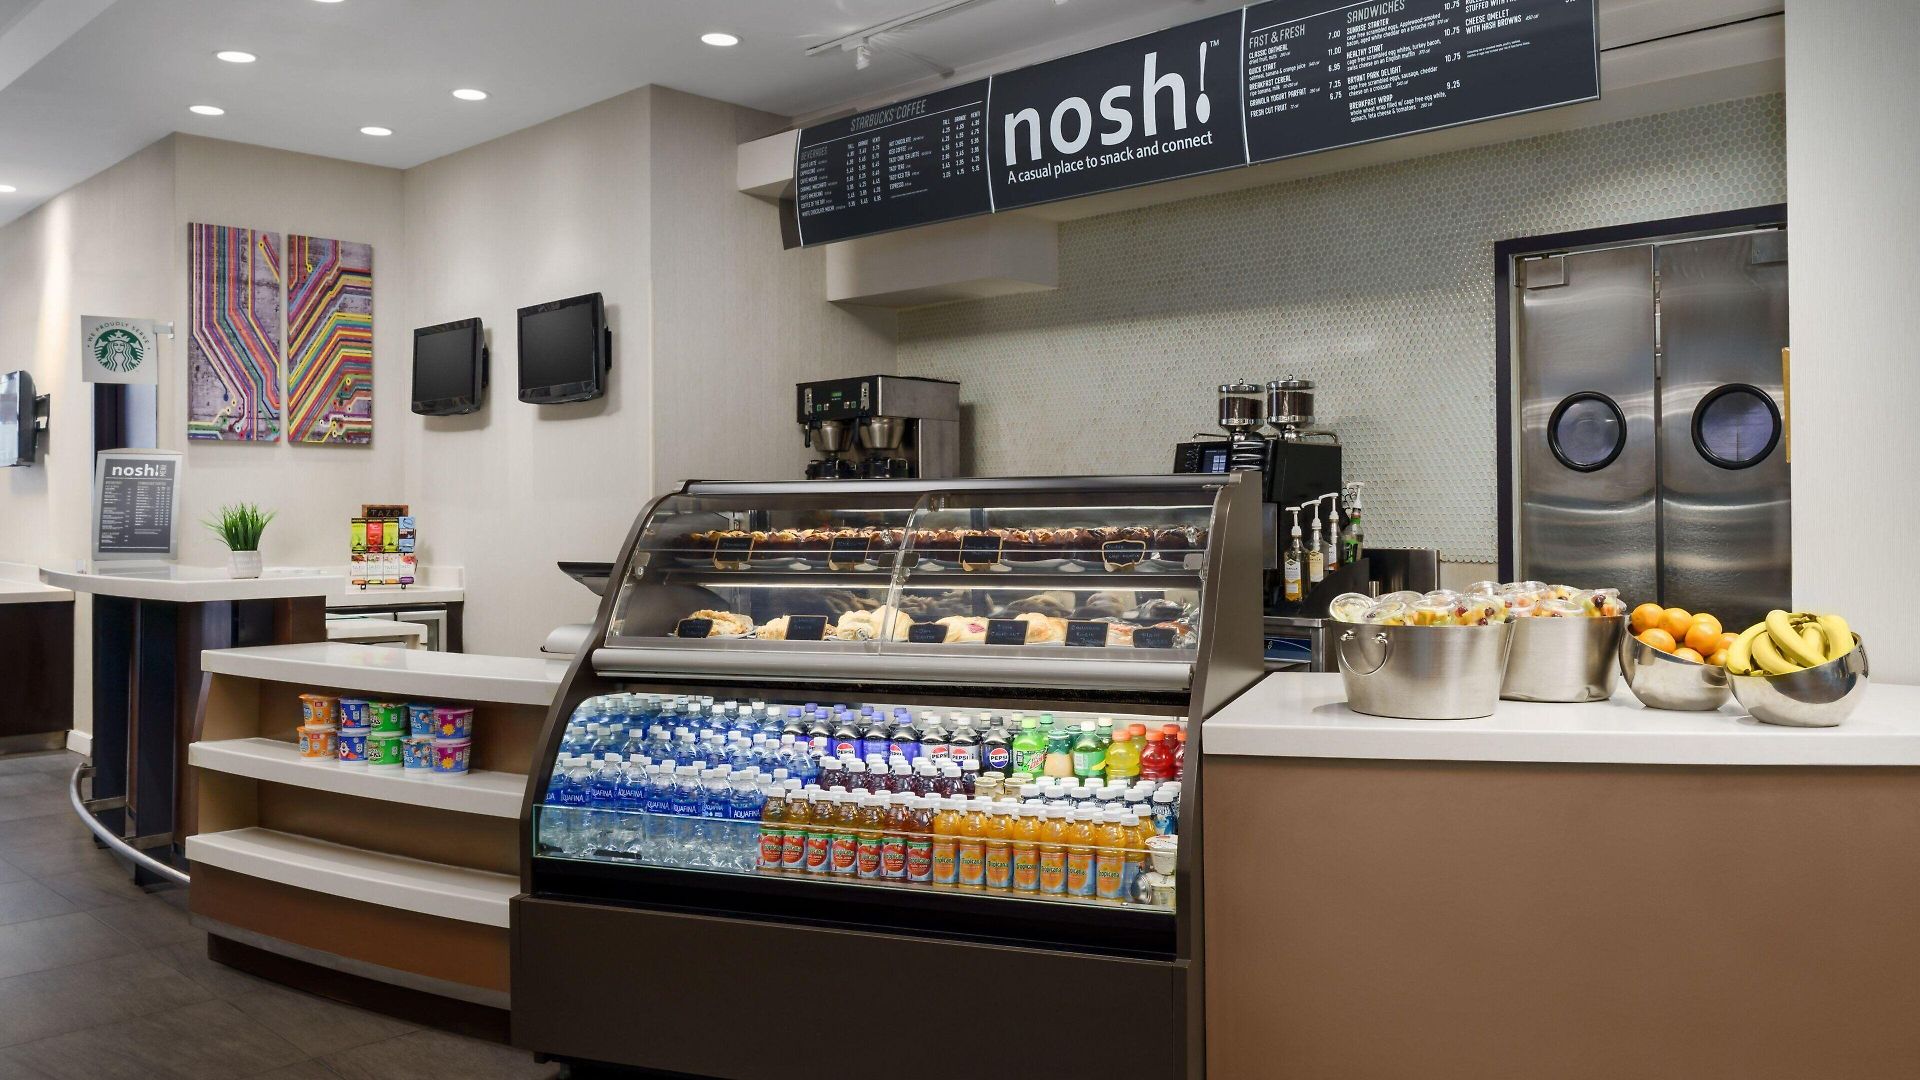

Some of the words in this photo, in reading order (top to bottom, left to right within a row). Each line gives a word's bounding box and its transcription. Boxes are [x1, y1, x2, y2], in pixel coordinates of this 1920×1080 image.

[1444, 0, 1460, 10] 10.75
[1466, 2, 1488, 13] STUFFED
[1347, 0, 1405, 23] SANDWICHES
[1466, 15, 1485, 26] CHEESE
[1487, 9, 1509, 21] OMELET
[1368, 18, 1389, 29] STARTER
[1466, 26, 1480, 34] WITH
[1482, 22, 1496, 31] HASH
[1498, 15, 1522, 27] BROWNS
[1250, 34, 1268, 49] FAST
[1271, 32, 1278, 43] &
[1280, 24, 1305, 40] FRESH
[1444, 26, 1460, 36] 10.75
[1249, 49, 1267, 59] CLASSIC
[1328, 47, 1341, 56] 11.00
[1347, 48, 1367, 59] HEALTHY
[1368, 44, 1383, 54] START
[1445, 52, 1460, 62] 10.75
[1249, 66, 1261, 75] QUICK
[1263, 62, 1276, 72] START
[1367, 71, 1380, 80] PARK
[1381, 66, 1401, 76] DELIGHT
[1249, 79, 1274, 90] BREAKFAST
[1275, 75, 1291, 84] CEREAL
[1447, 80, 1460, 89] 9.25
[1330, 91, 1342, 100] 6.75
[1004, 41, 1210, 166] nosh!
[1250, 97, 1269, 106] GRANOLA
[1349, 98, 1376, 110] BREAKFAST
[1378, 94, 1393, 103] WRAP
[896, 99, 927, 119] COFFEE
[1251, 109, 1264, 117] FRESH
[1265, 106, 1274, 115] CUT
[1275, 103, 1287, 112] FRUIT
[1008, 170, 1016, 184] A
[1018, 162, 1051, 182] casual
[1055, 157, 1083, 178] place
[1086, 155, 1097, 168] to
[1100, 147, 1134, 166] snack
[1137, 141, 1159, 159] and
[1162, 130, 1213, 153] connect
[112, 464, 159, 476] nosh!
[371, 509, 399, 517] TAZO
[561, 790, 585, 803] QUAFINA
[591, 789, 613, 798] QUAFINA
[618, 788, 643, 798] AQUAFINA
[647, 801, 670, 811] QUAFINA
[674, 804, 697, 813] QUAFINA
[733, 809, 761, 819] AQUAFINA
